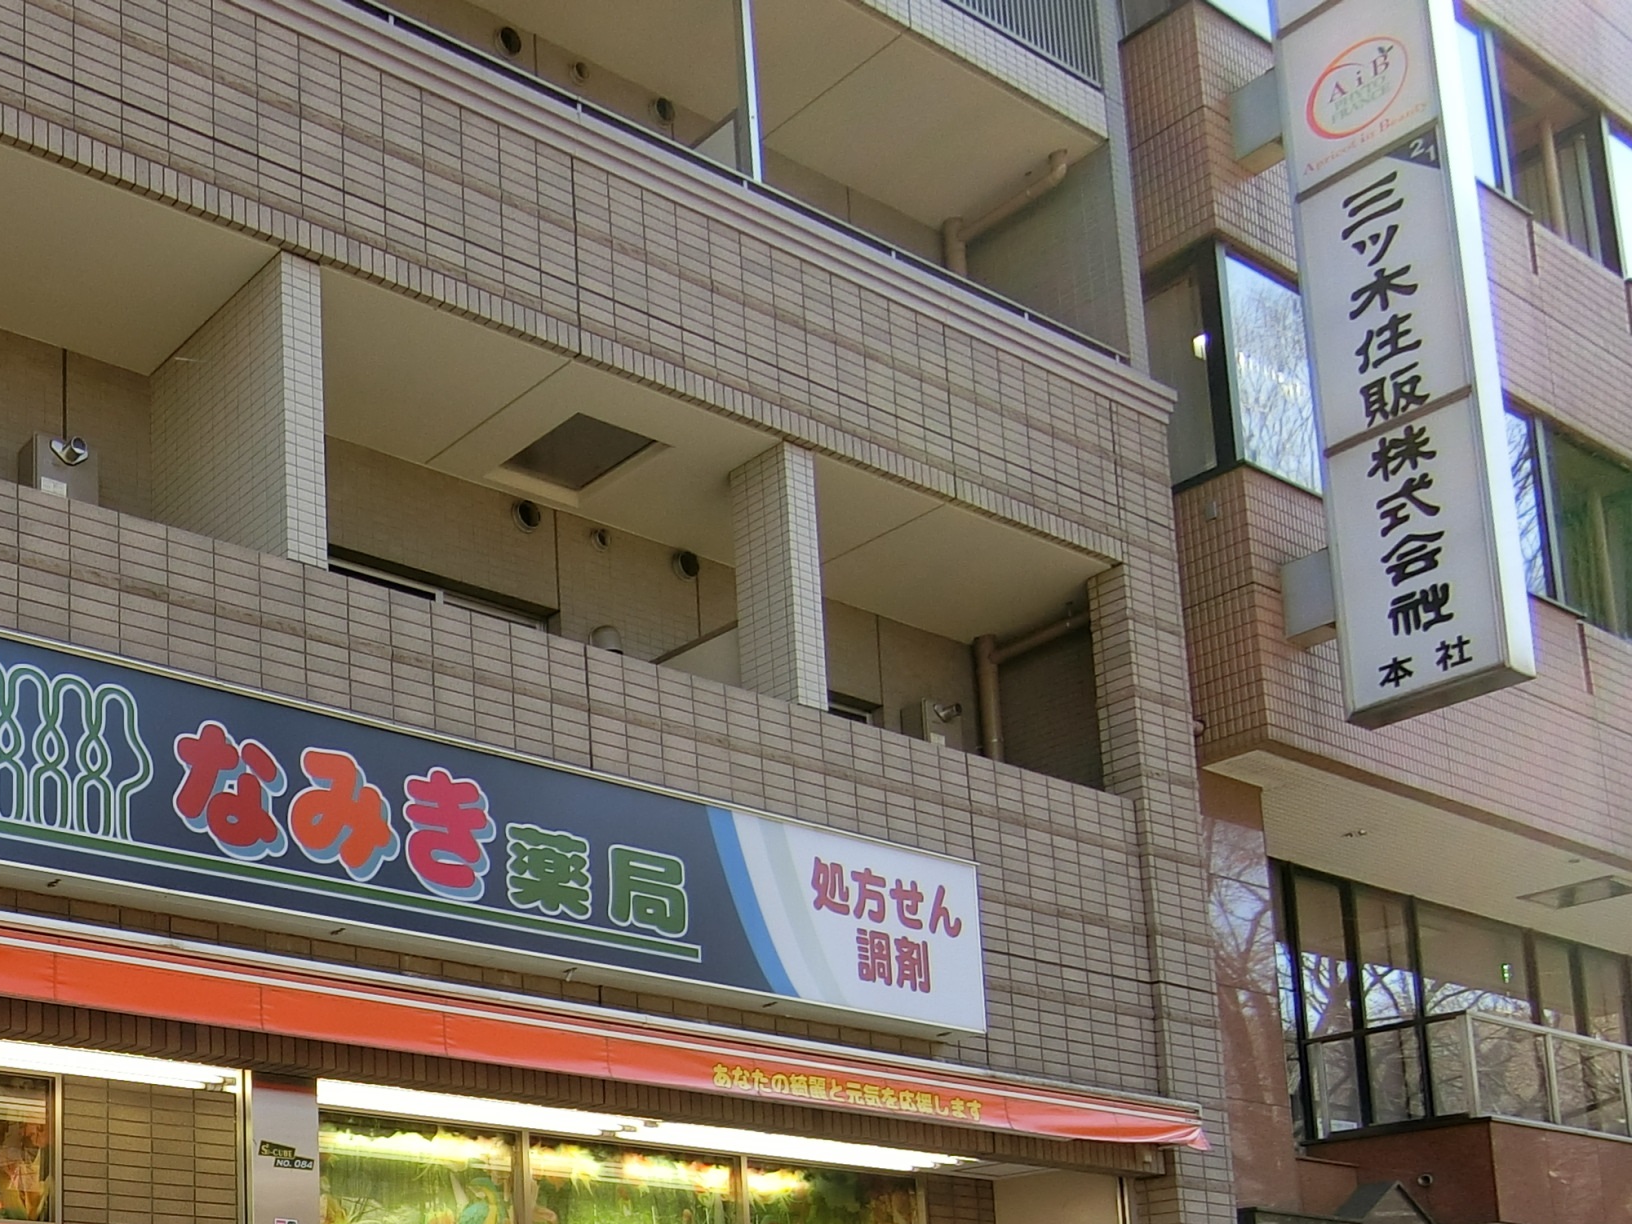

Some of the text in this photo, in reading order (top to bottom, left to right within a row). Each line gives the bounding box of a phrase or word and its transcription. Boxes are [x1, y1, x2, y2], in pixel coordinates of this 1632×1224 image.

[1409, 139, 1436, 161] 21
[1340, 171, 1454, 636] 三ツ木住販株式会社
[1379, 636, 1472, 688] 本社
[172, 719, 689, 938] なみき薬局
[811, 856, 963, 940] 処方せん
[857, 928, 931, 993] 調剤
[712, 1063, 982, 1123] あなたの綺麗と元気を応援します
[276, 1159, 313, 1169] NO. 084
